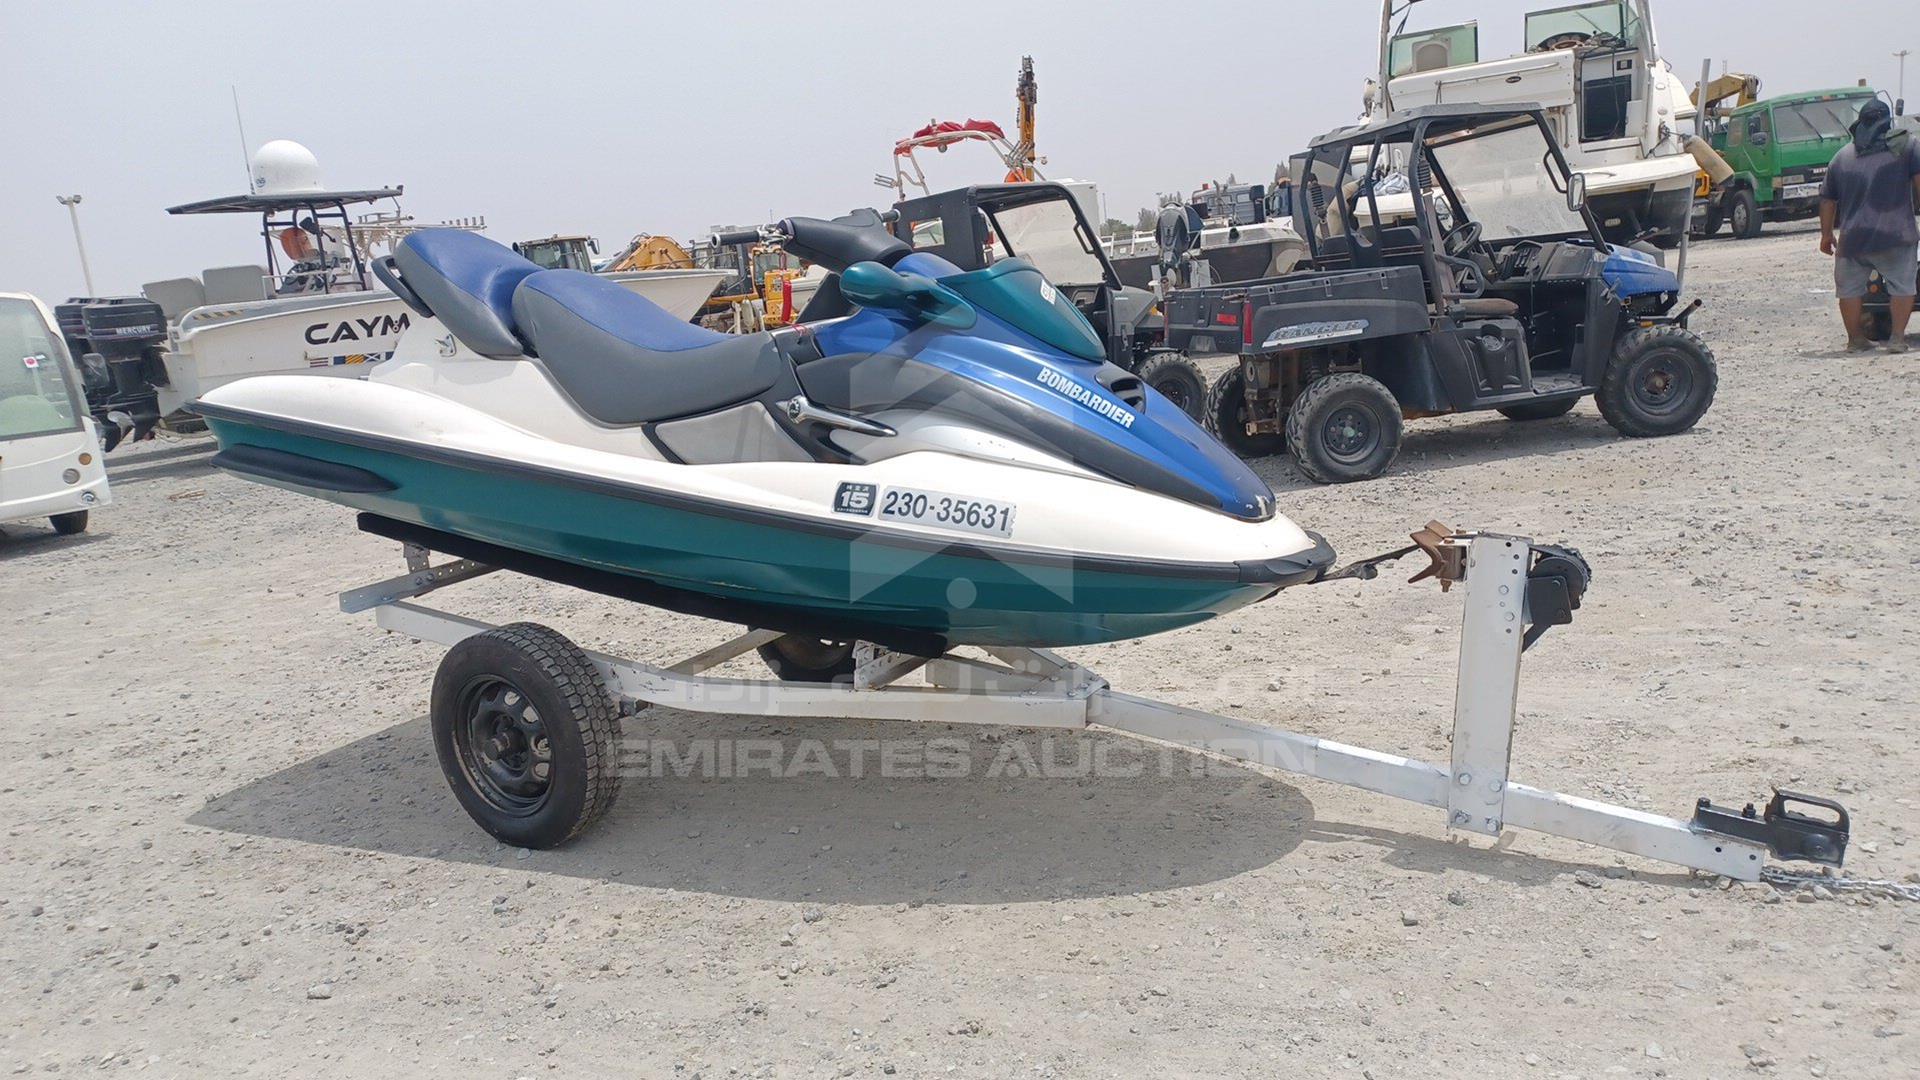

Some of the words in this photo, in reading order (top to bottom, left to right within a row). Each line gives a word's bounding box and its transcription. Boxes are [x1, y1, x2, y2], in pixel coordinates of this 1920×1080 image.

[115, 325, 152, 336] MERCURY
[1036, 366, 1136, 429] BOMBARDIER
[841, 491, 870, 509] 15
[882, 490, 1010, 532] 230-35631
